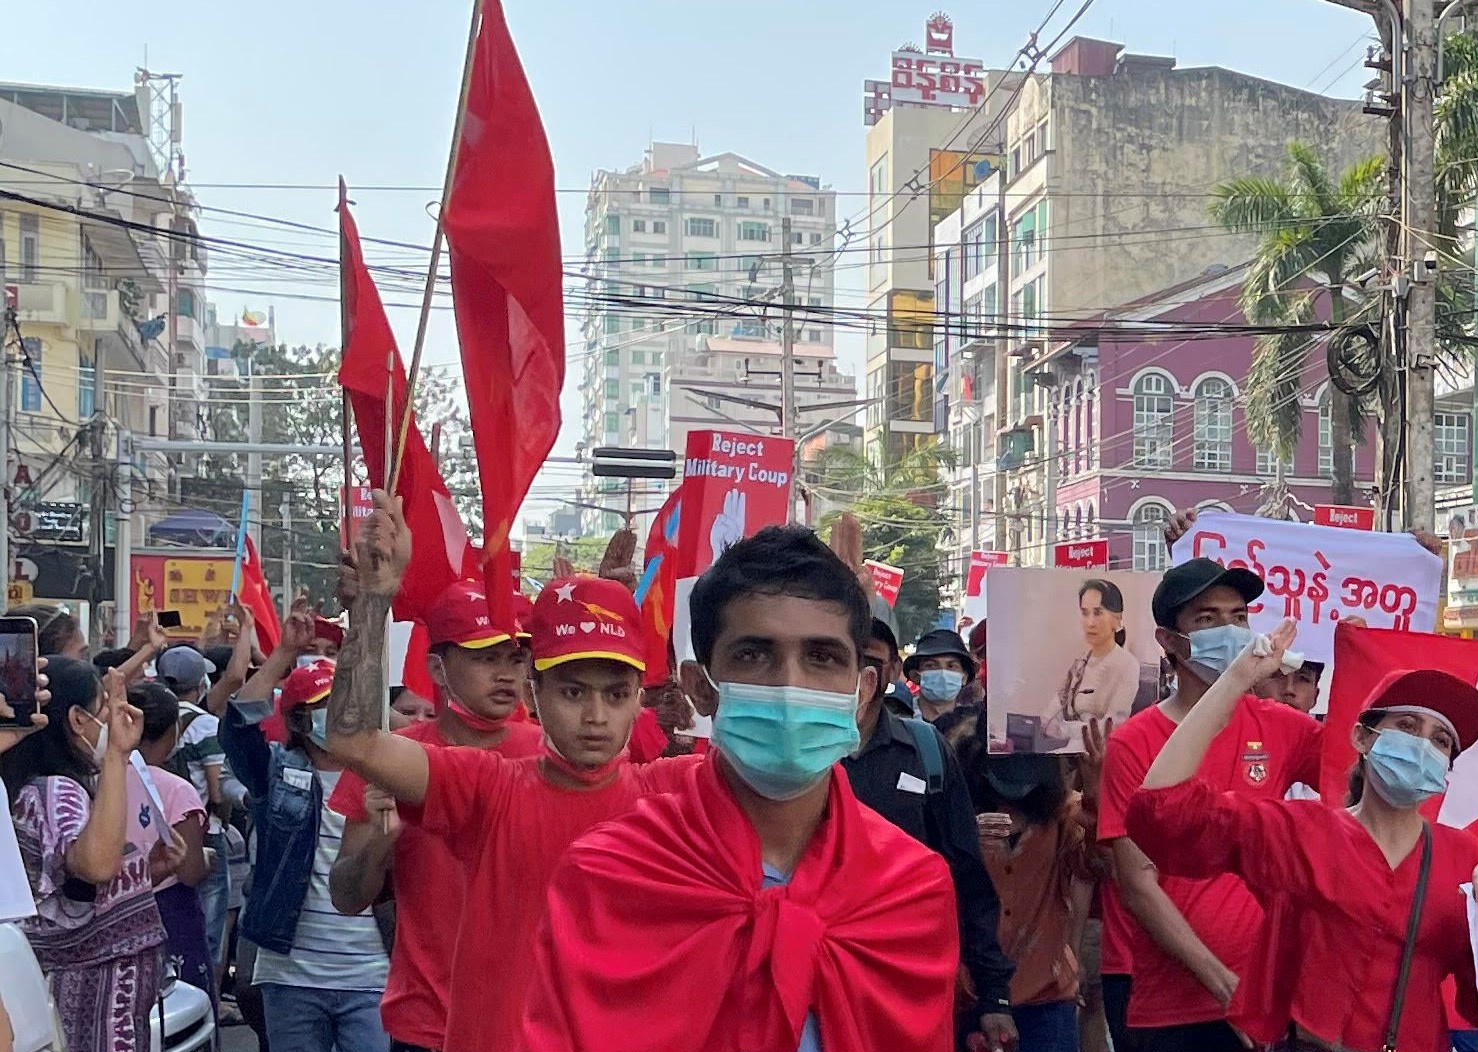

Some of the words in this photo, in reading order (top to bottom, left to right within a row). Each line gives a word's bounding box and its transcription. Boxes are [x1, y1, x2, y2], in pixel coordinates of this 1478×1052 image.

[711, 433, 764, 457] Reject
[685, 458, 745, 483] Military
[748, 462, 788, 488] Coup
[1329, 508, 1358, 526] Reject
[556, 624, 575, 635] We
[600, 623, 625, 638] NLD
